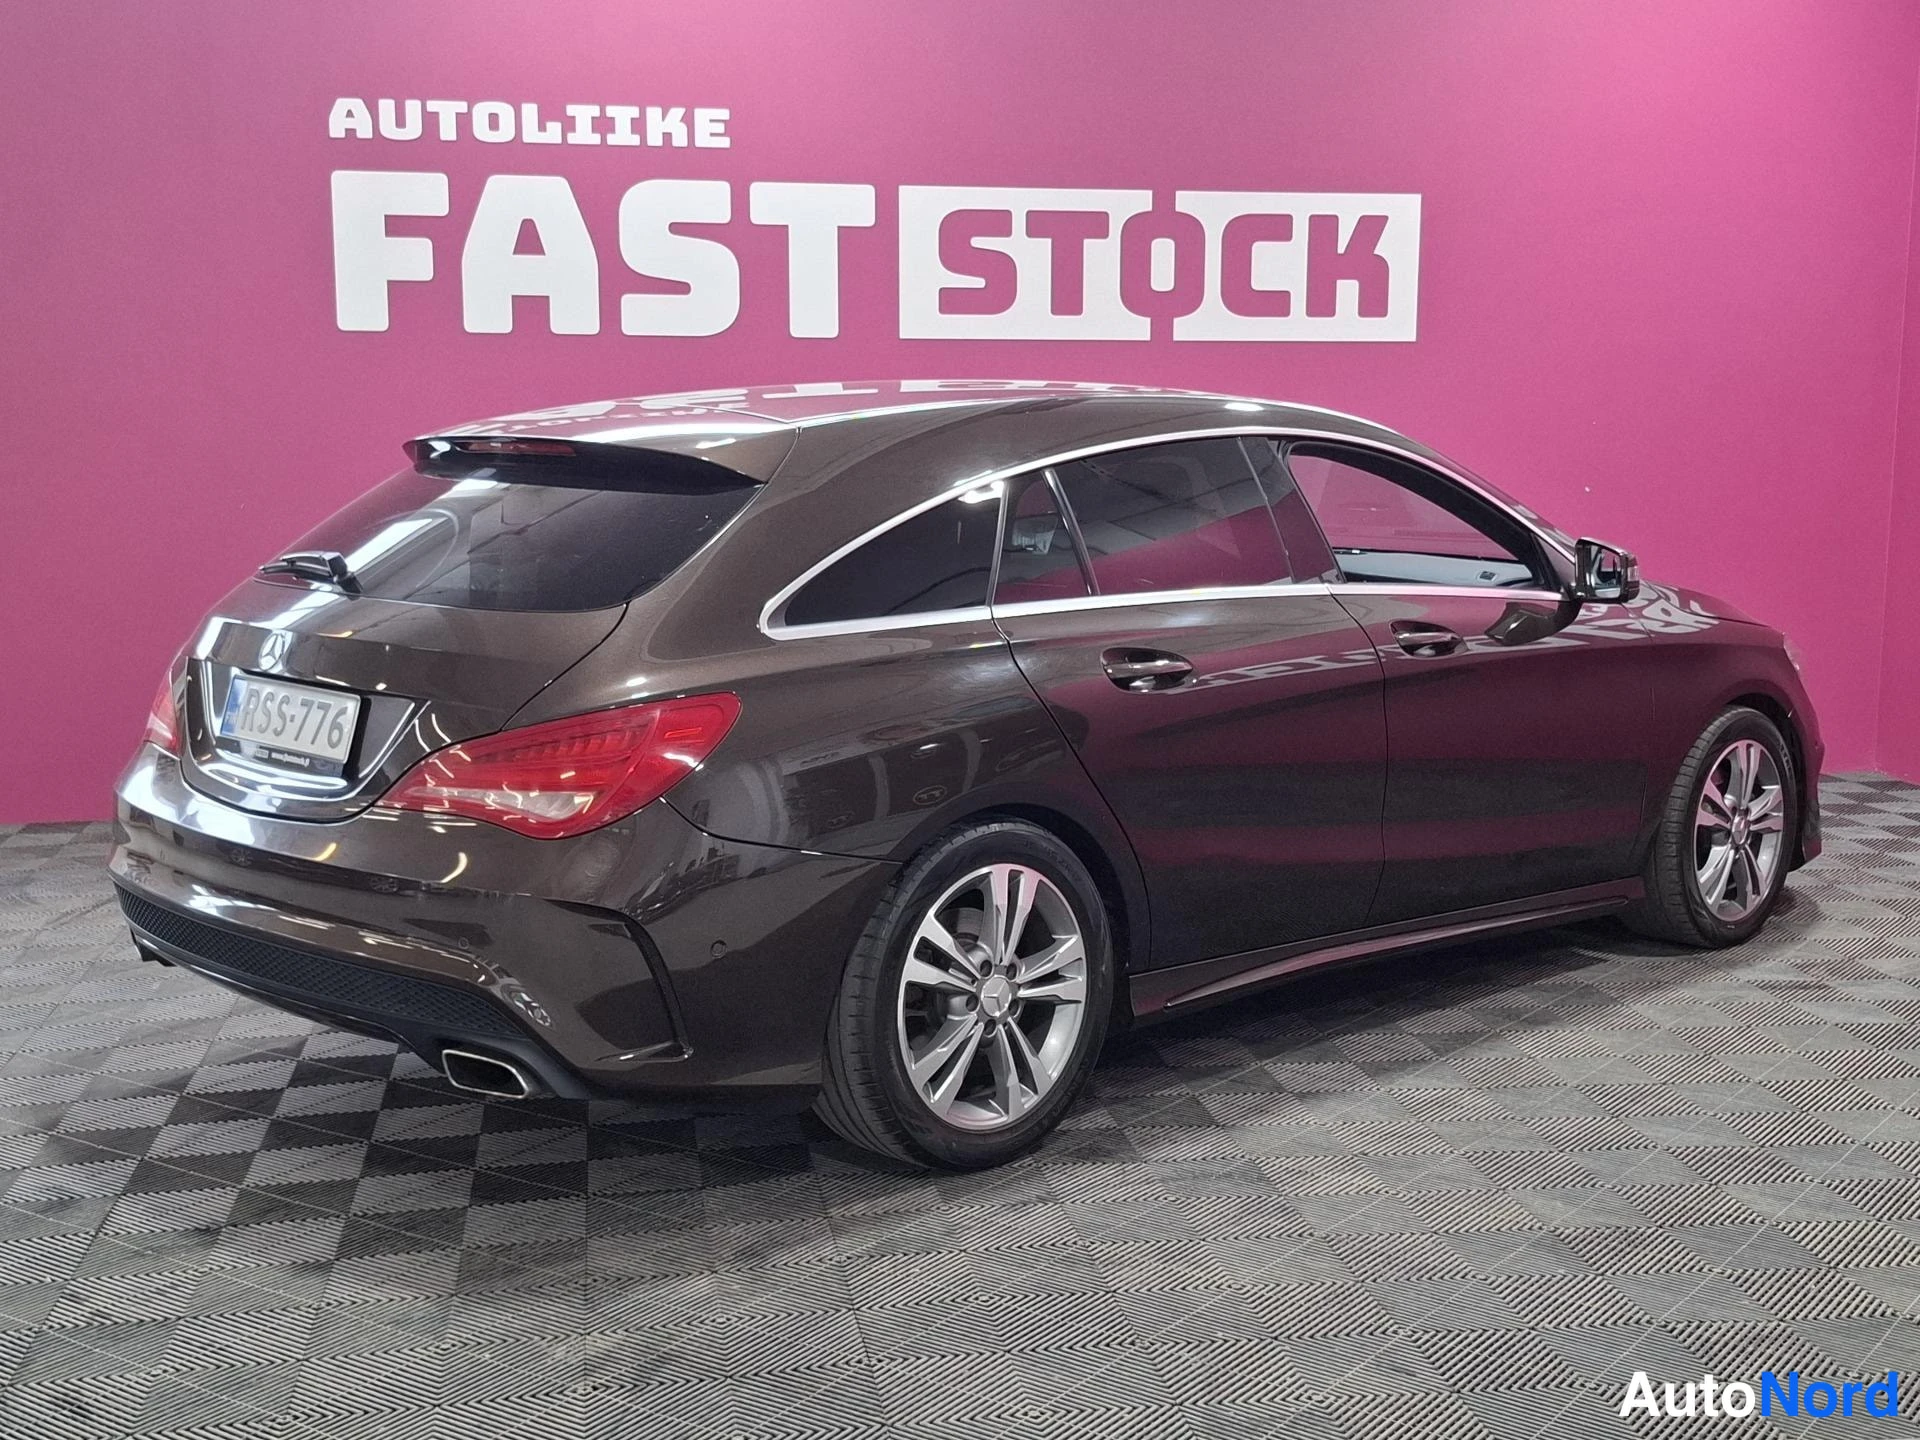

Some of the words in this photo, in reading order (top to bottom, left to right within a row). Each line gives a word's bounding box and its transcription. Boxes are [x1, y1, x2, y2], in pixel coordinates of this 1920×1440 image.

[328, 97, 732, 149] AUTOLIIKE
[330, 169, 876, 339] FAST
[938, 209, 1390, 318] STOCK
[240, 687, 349, 750] RSS-776
